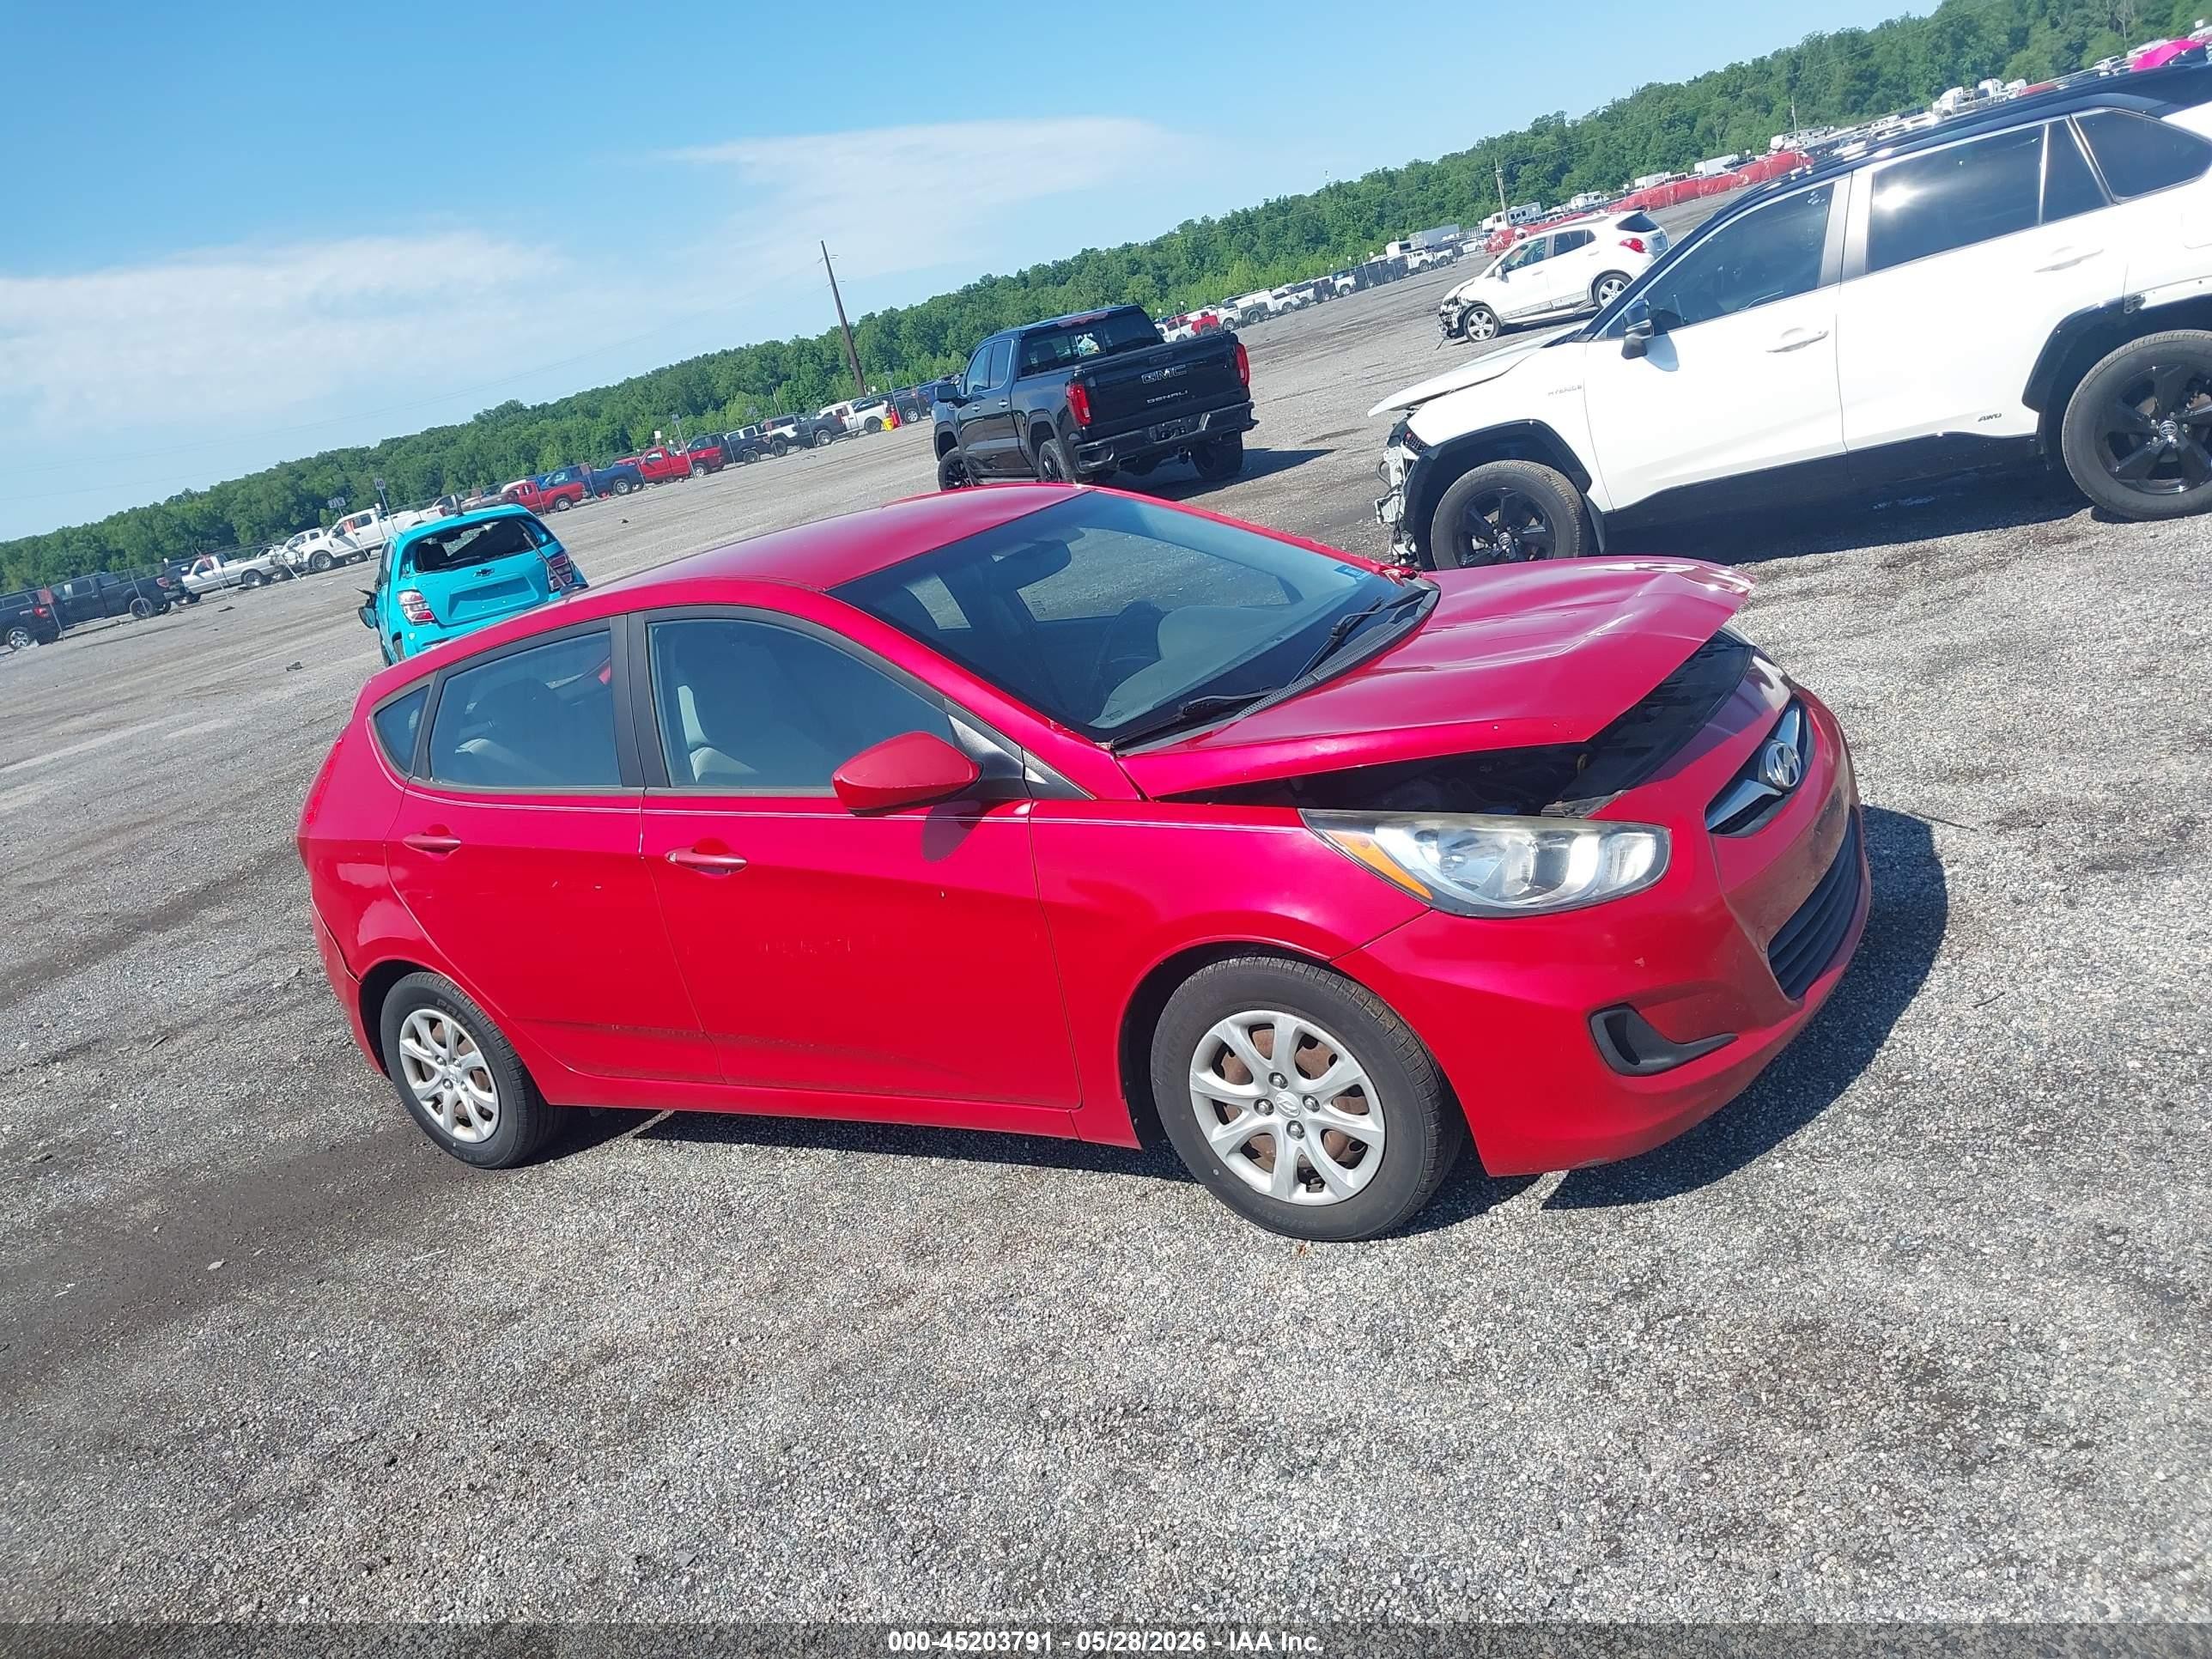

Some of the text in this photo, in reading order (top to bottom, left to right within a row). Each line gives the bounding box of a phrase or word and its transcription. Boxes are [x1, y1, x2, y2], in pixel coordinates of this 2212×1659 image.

[1140, 364, 1188, 384] GMC
[1146, 389, 1188, 404] DENALI
[1978, 412, 2002, 422] AWD
